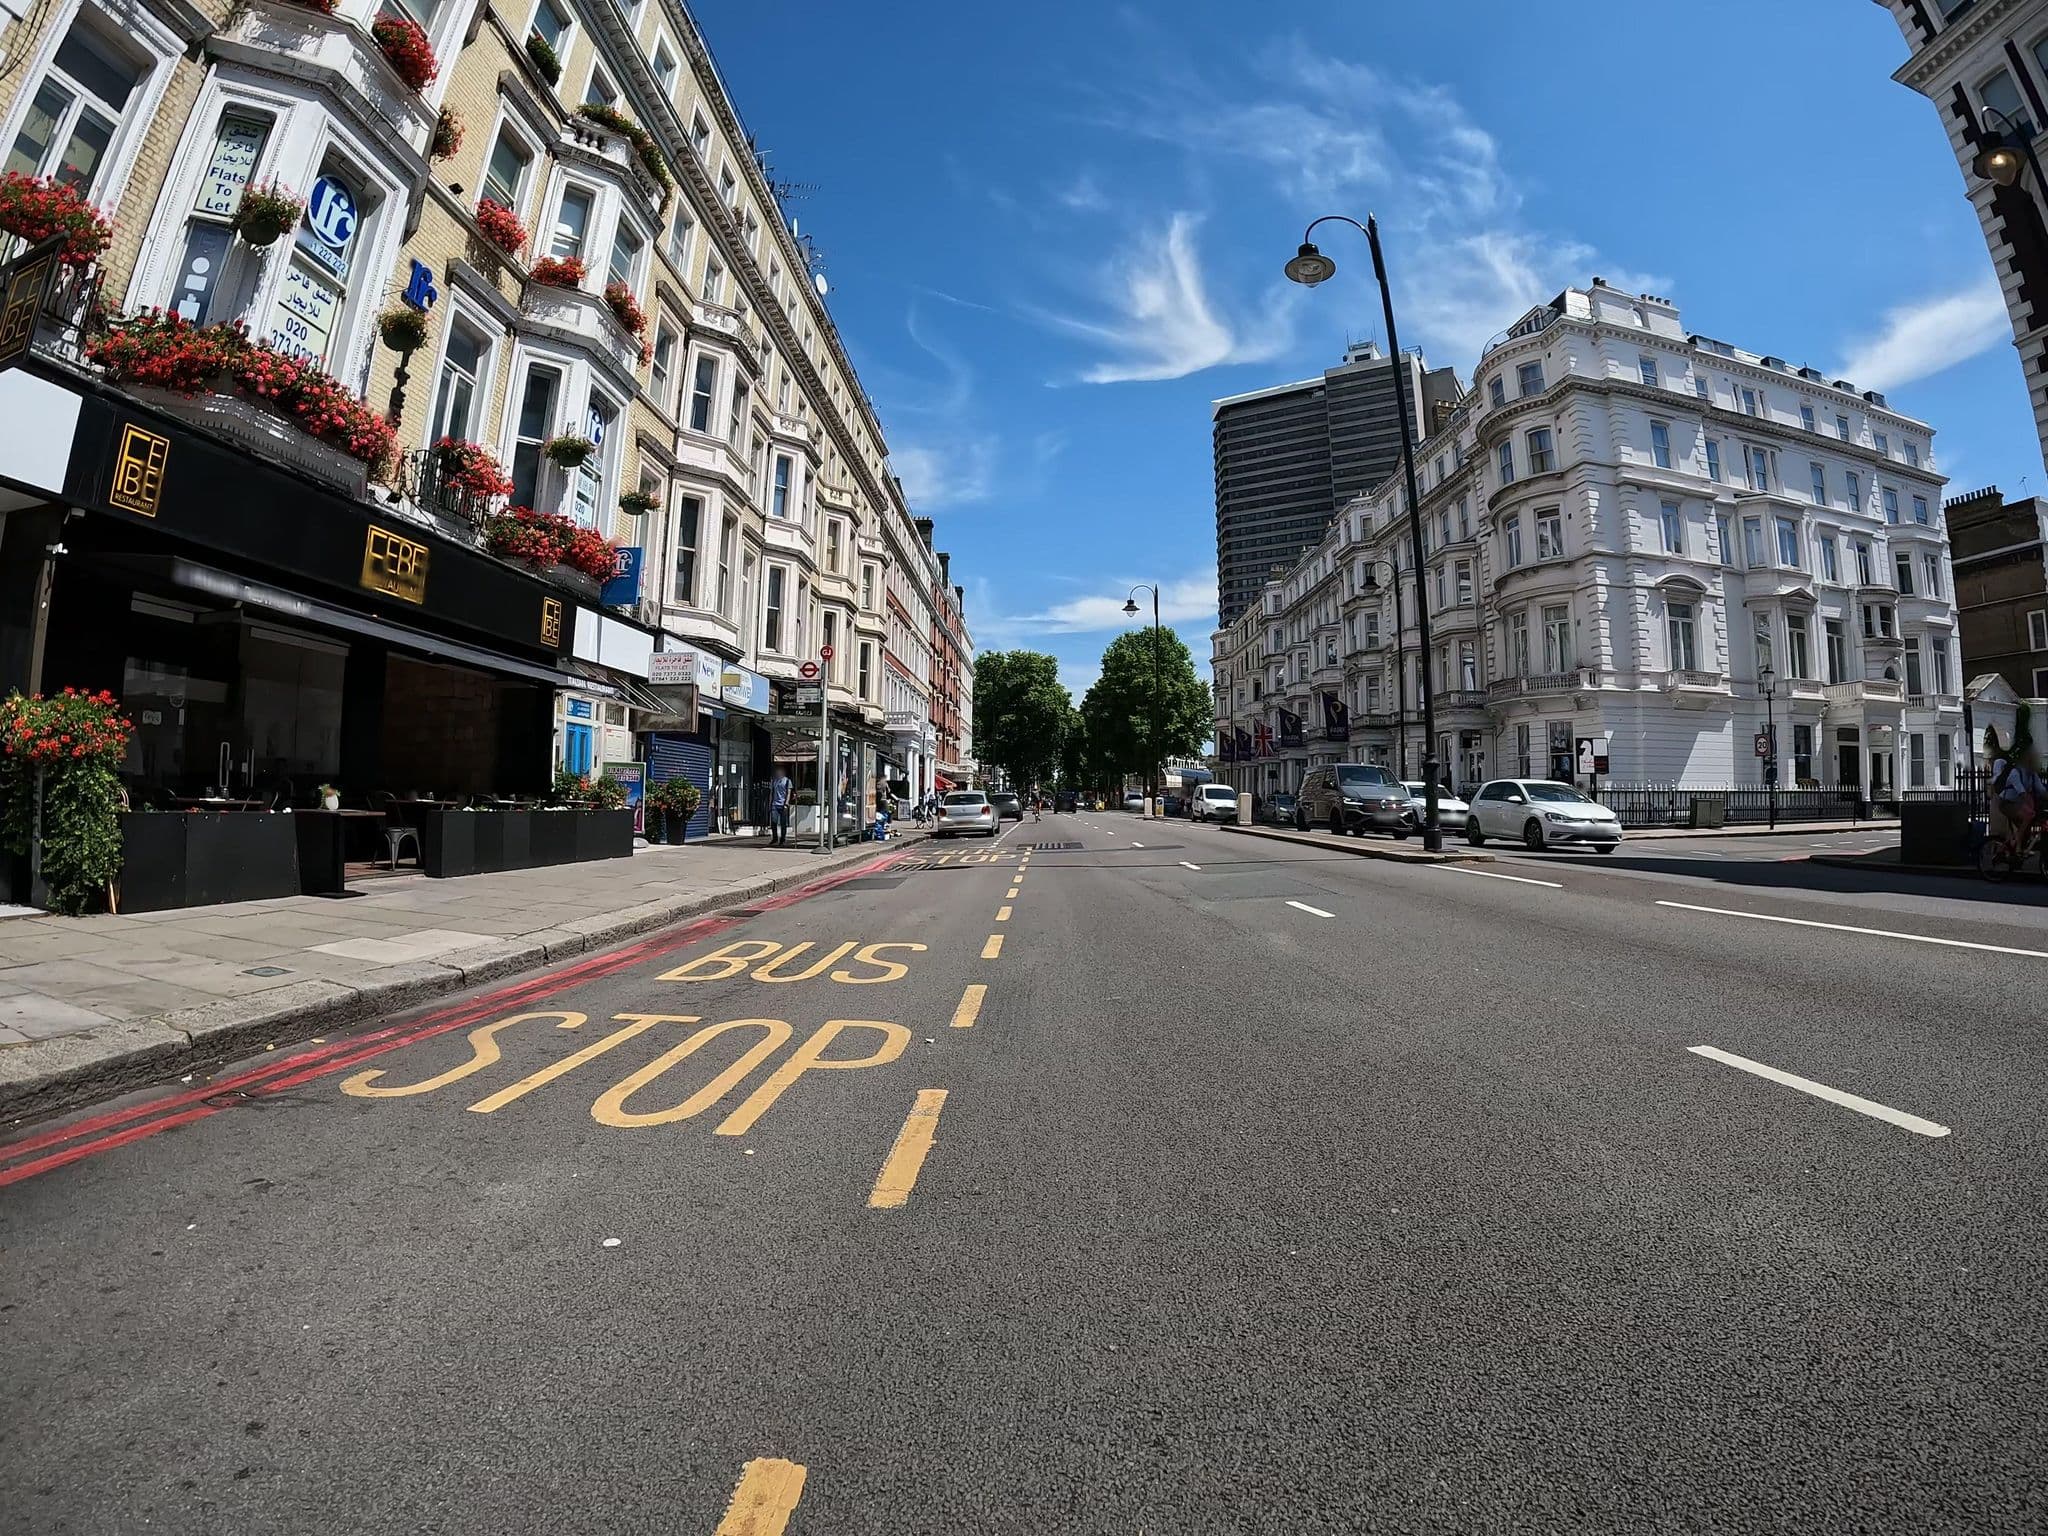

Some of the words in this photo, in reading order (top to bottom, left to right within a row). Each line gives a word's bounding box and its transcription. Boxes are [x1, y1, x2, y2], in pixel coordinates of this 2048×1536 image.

[210, 167, 246, 184] Flats
[216, 183, 232, 197] To
[205, 198, 231, 212] Let
[286, 317, 308, 341] 020
[1758, 741, 1767, 749] 20
[900, 854, 1017, 864] STOP
[653, 940, 928, 984] BUS
[339, 1011, 912, 1136] STOP
